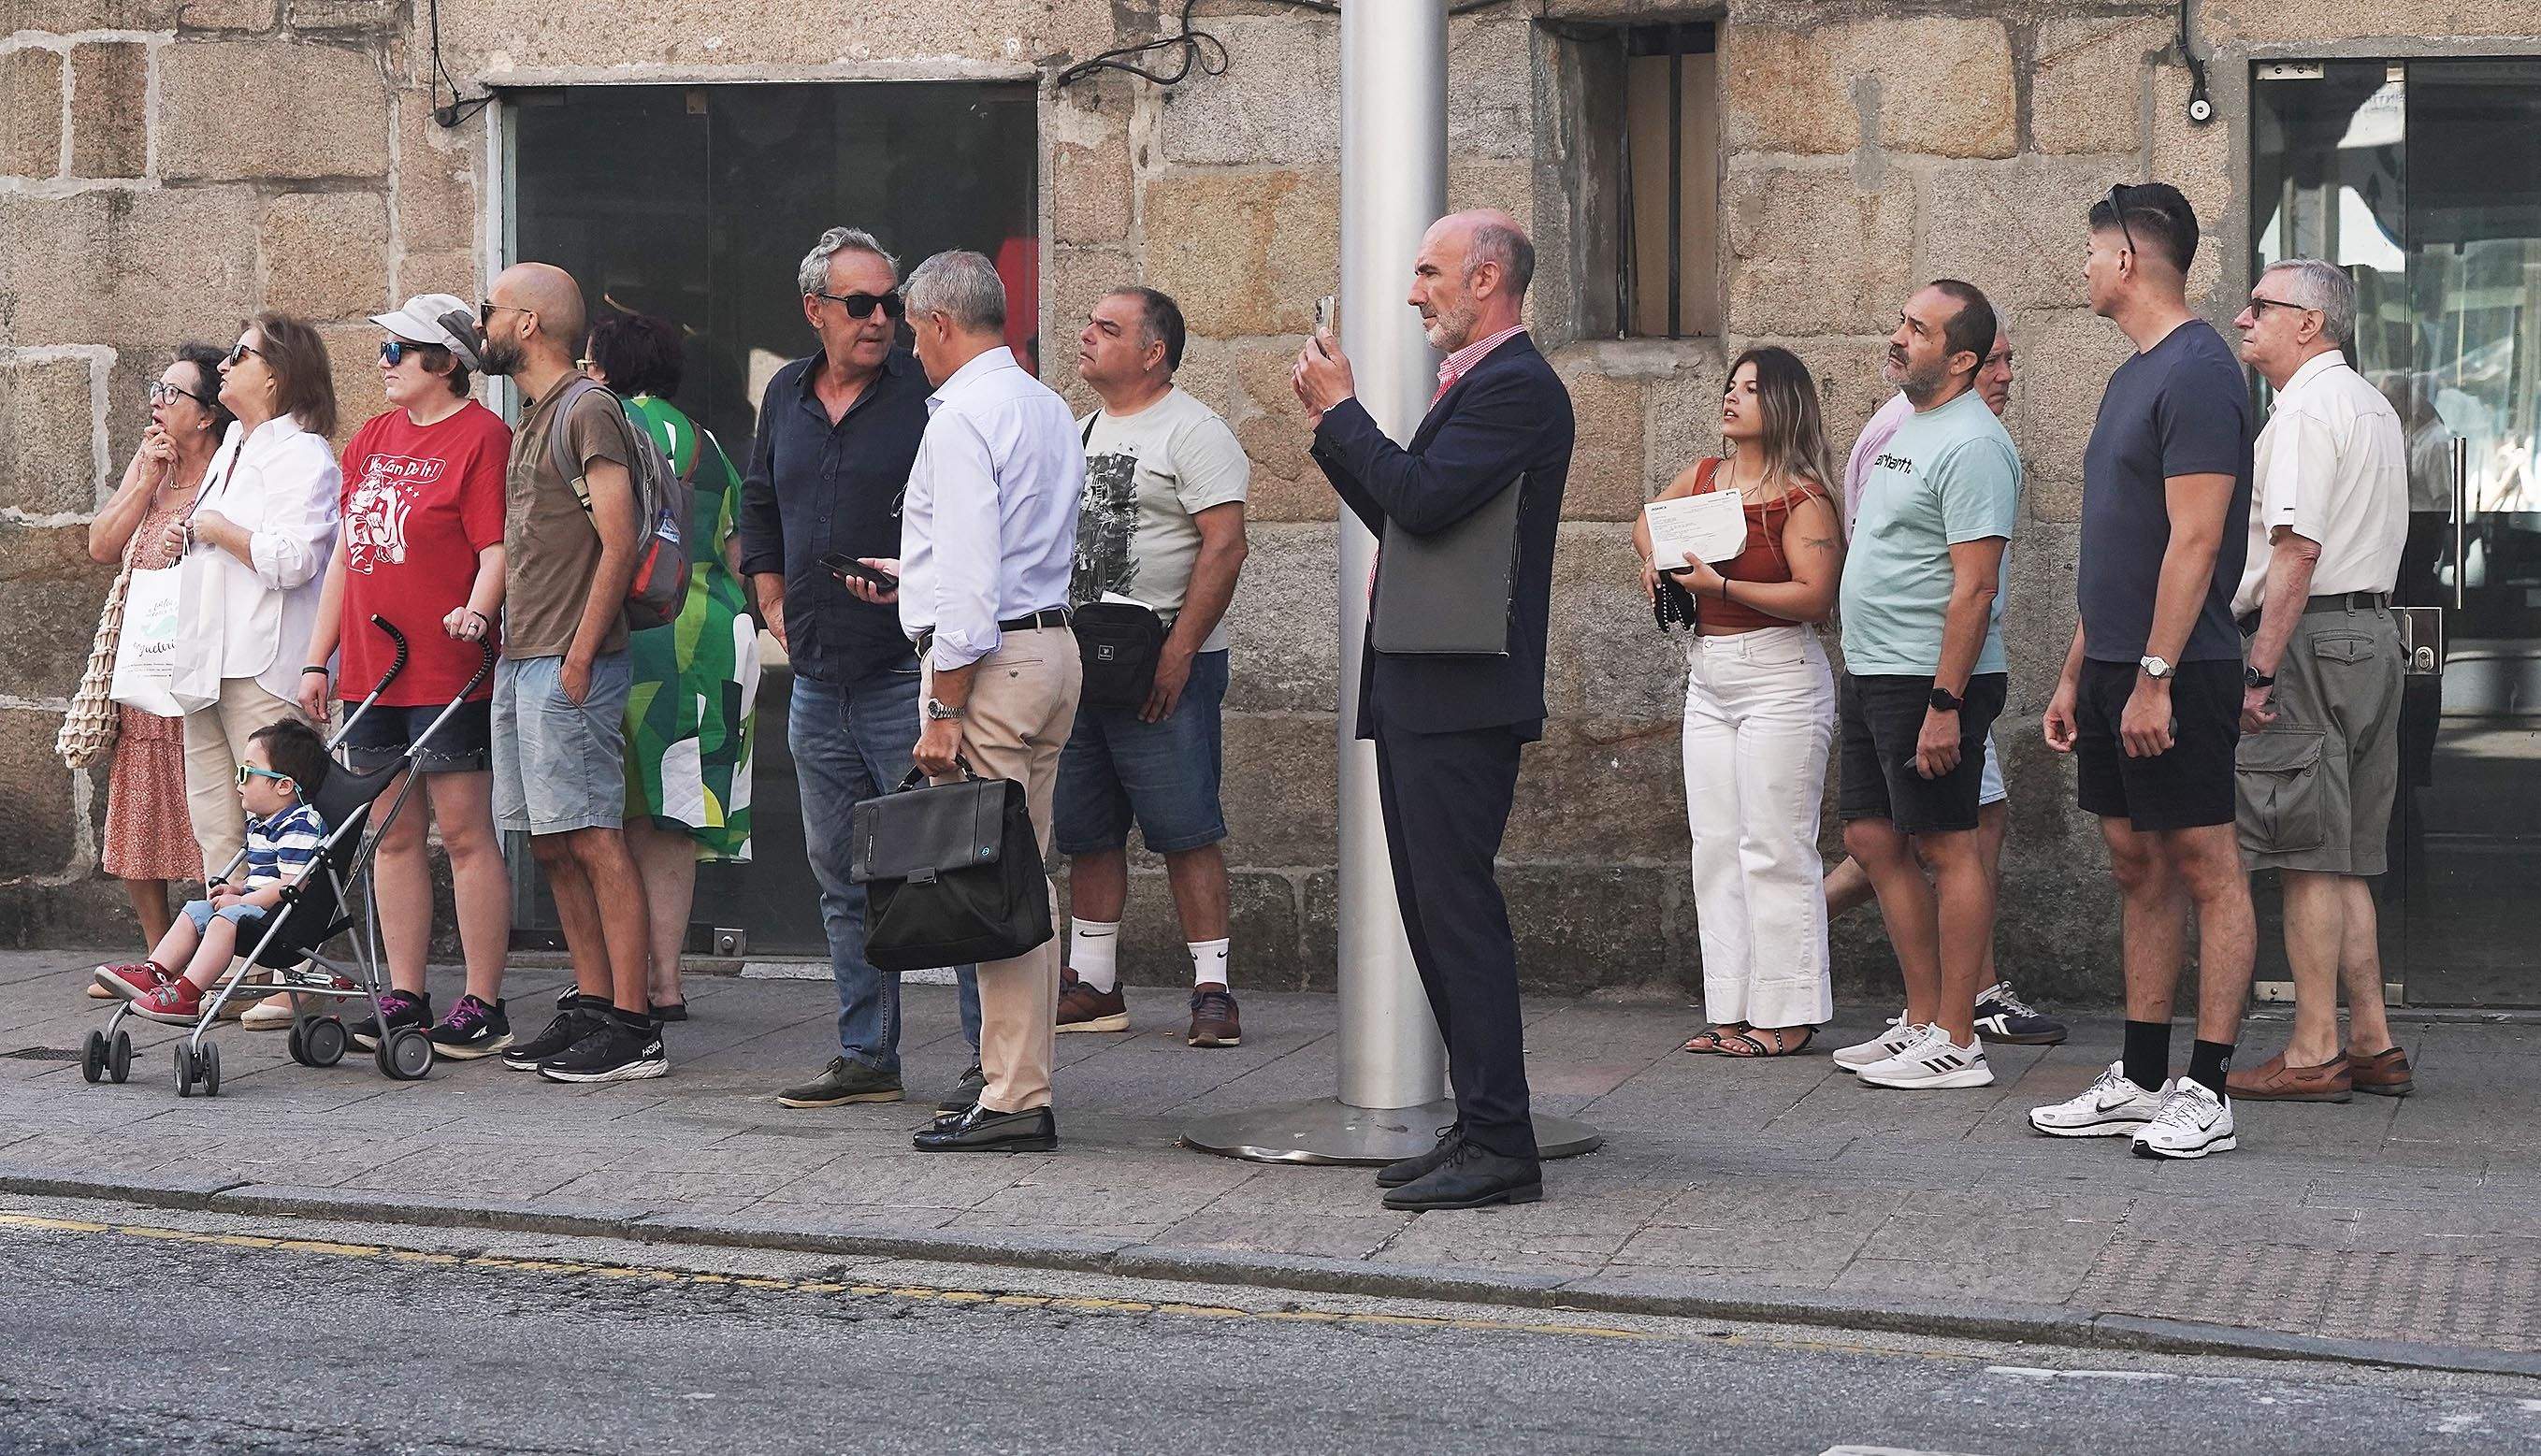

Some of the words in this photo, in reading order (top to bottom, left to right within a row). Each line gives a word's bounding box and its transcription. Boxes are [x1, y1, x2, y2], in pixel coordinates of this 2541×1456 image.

[382, 459, 404, 476] Can
[403, 461, 420, 477] Do
[419, 461, 440, 478] It!
[1873, 453, 1913, 474] arhartt.
[642, 1040, 662, 1058] HOKA
